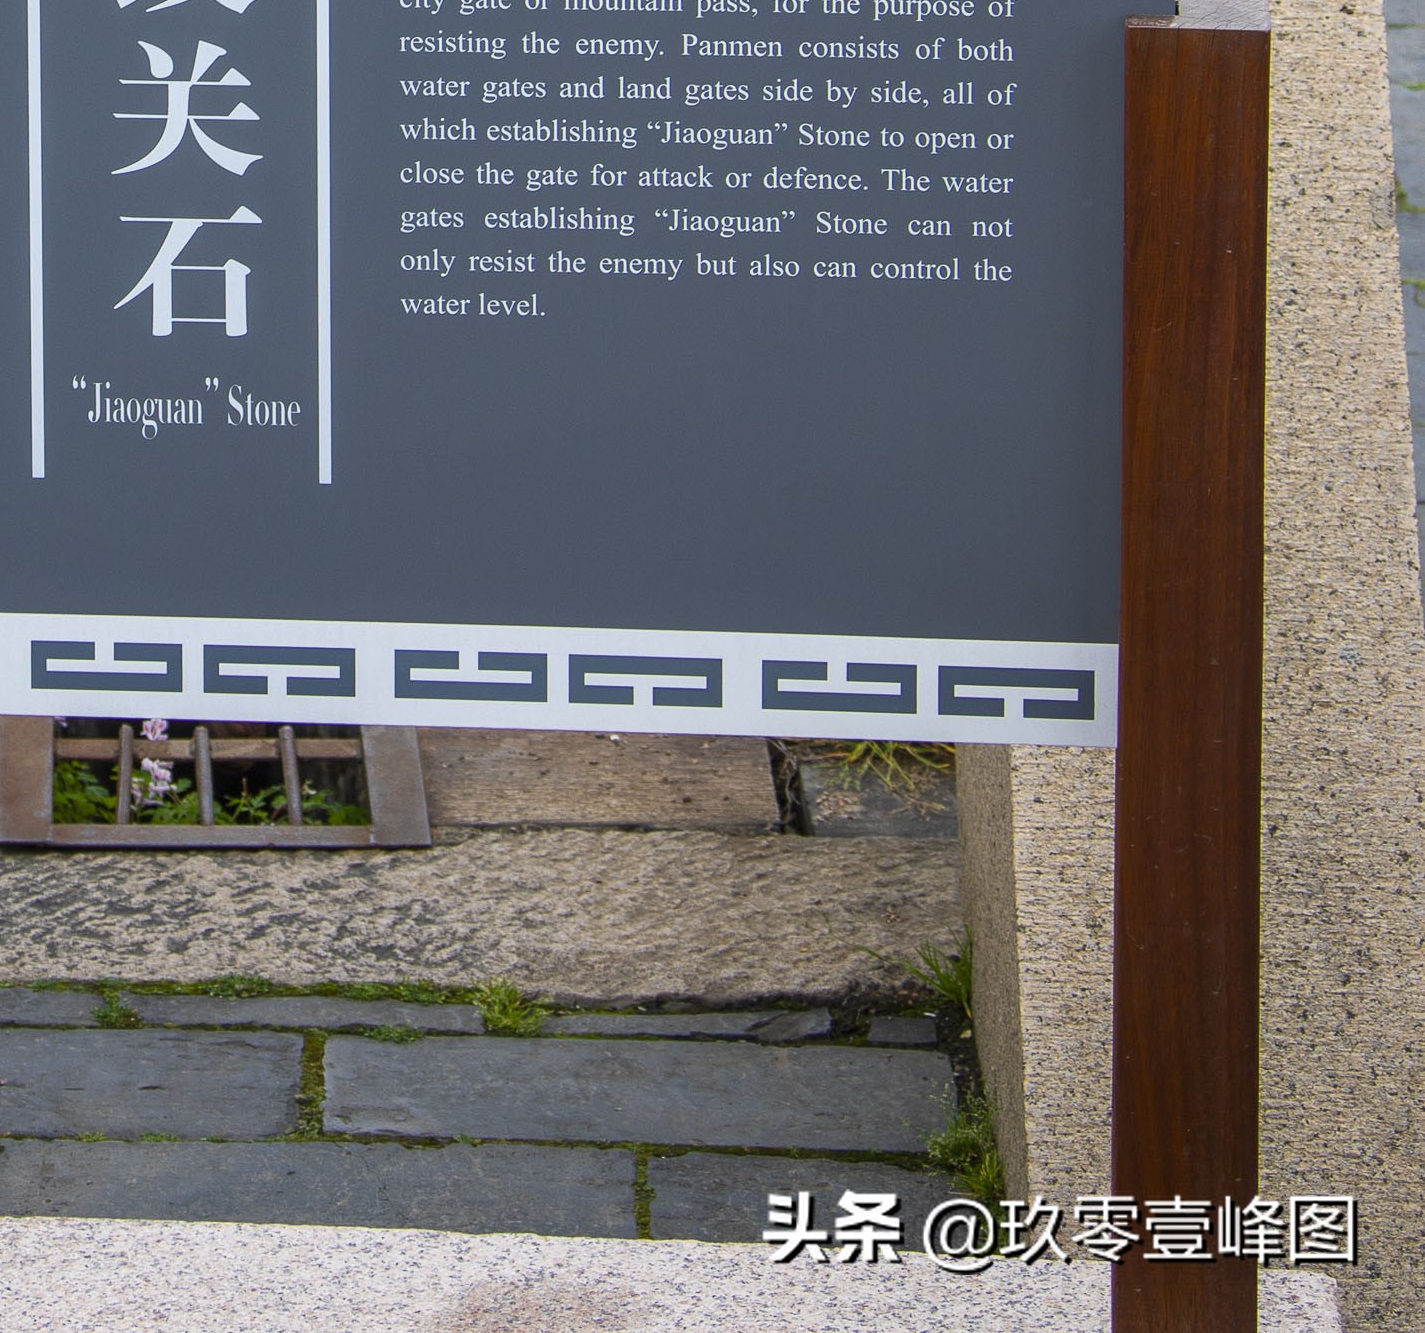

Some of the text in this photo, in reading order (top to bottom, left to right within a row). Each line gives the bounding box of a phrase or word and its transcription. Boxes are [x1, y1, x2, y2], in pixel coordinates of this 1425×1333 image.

[399, 29, 1014, 62] resisting the enemy. Panmen consists of both
[399, 75, 1018, 109] water gates and land gates side by side, all of
[399, 117, 477, 141] which
[486, 118, 638, 149] establishing
[798, 122, 870, 147] Stone
[880, 127, 905, 148] to
[914, 131, 977, 155] open
[986, 133, 1015, 150] or
[399, 160, 1014, 194] close the gate for attack or defence. The water
[399, 207, 465, 234] gates
[484, 205, 635, 237] establishing
[816, 210, 888, 235] Stone
[907, 219, 952, 236] can
[971, 218, 1013, 238] not
[400, 248, 1013, 282] only resist the enemy but also can control the
[400, 292, 546, 317] water level.
[227, 384, 301, 427] Stone
